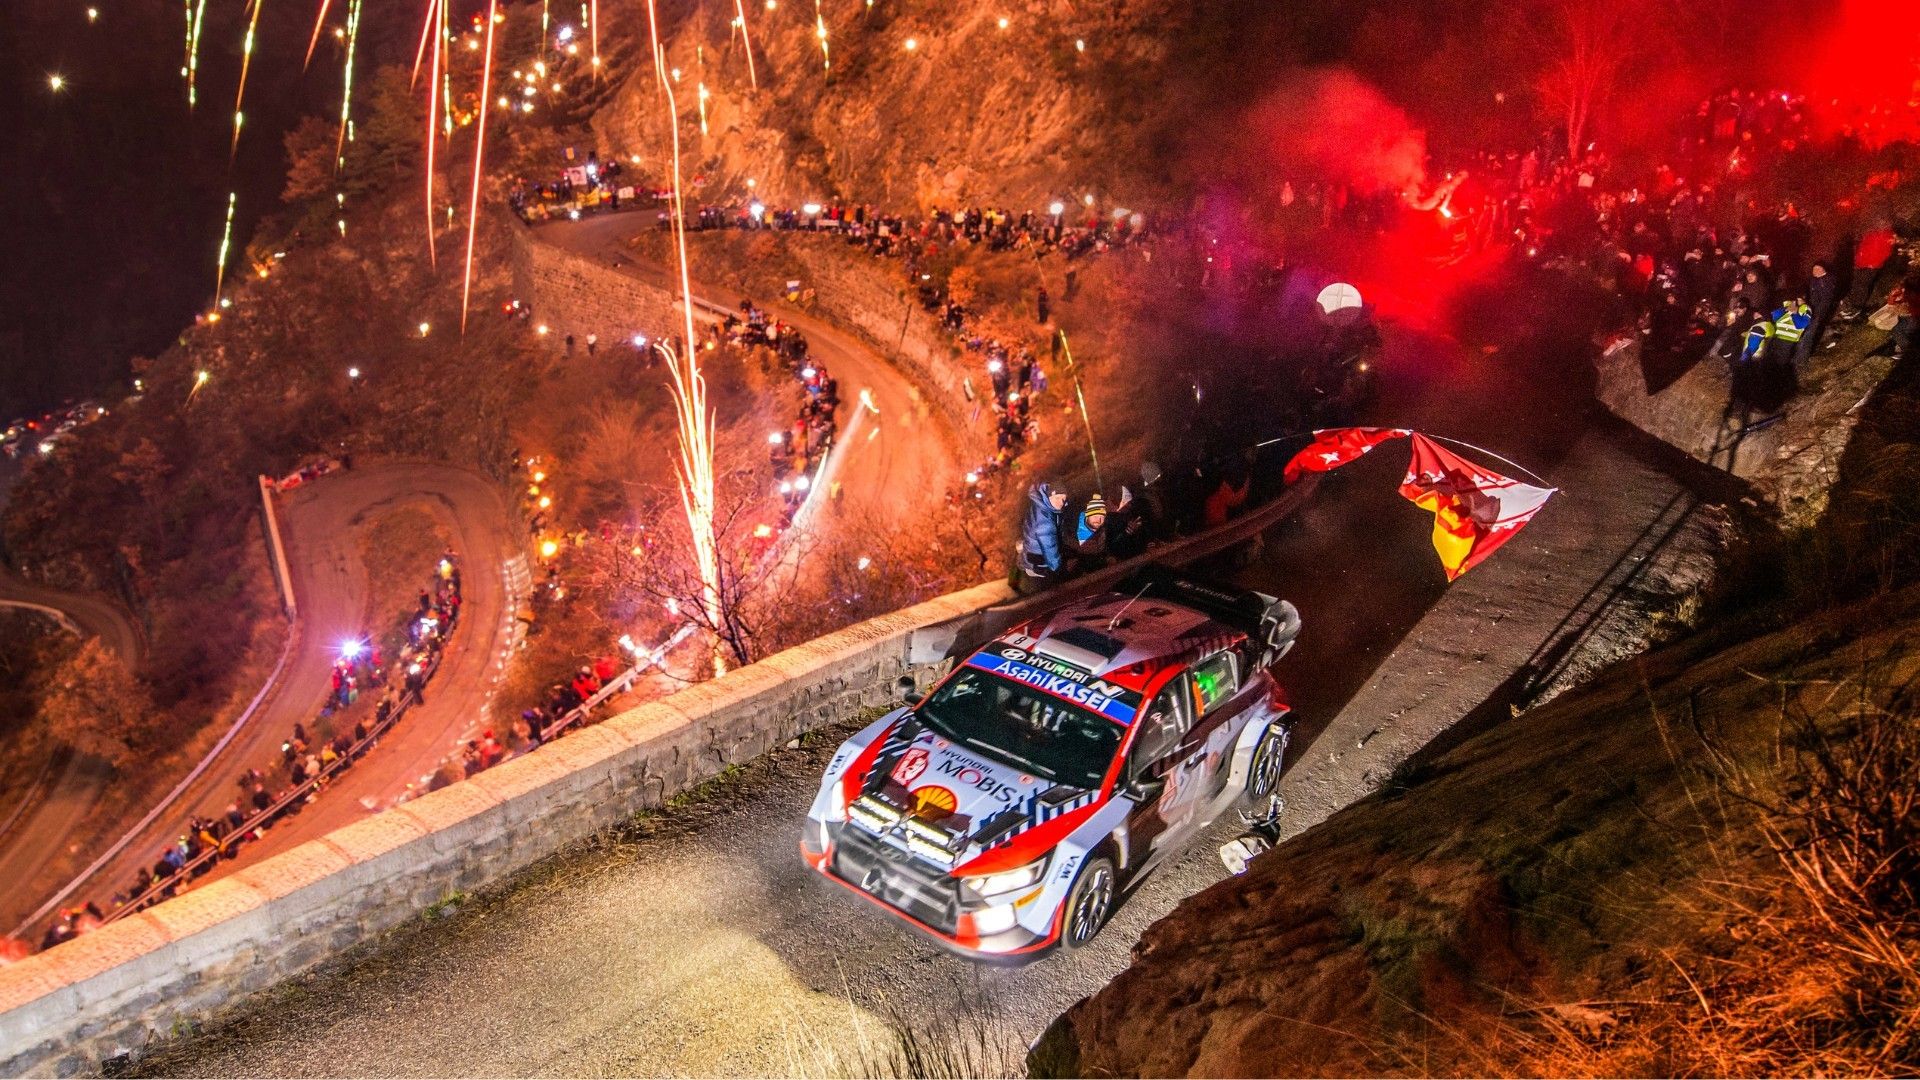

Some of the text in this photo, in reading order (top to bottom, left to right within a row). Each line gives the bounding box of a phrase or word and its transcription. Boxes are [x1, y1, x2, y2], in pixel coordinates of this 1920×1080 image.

[1013, 636, 1028, 645] 8
[993, 661, 1112, 712] AsahiKASEI
[1026, 656, 1126, 698] HYUNDAI N
[936, 760, 1017, 803] MOBIS
[940, 749, 993, 774] HYUNDAI
